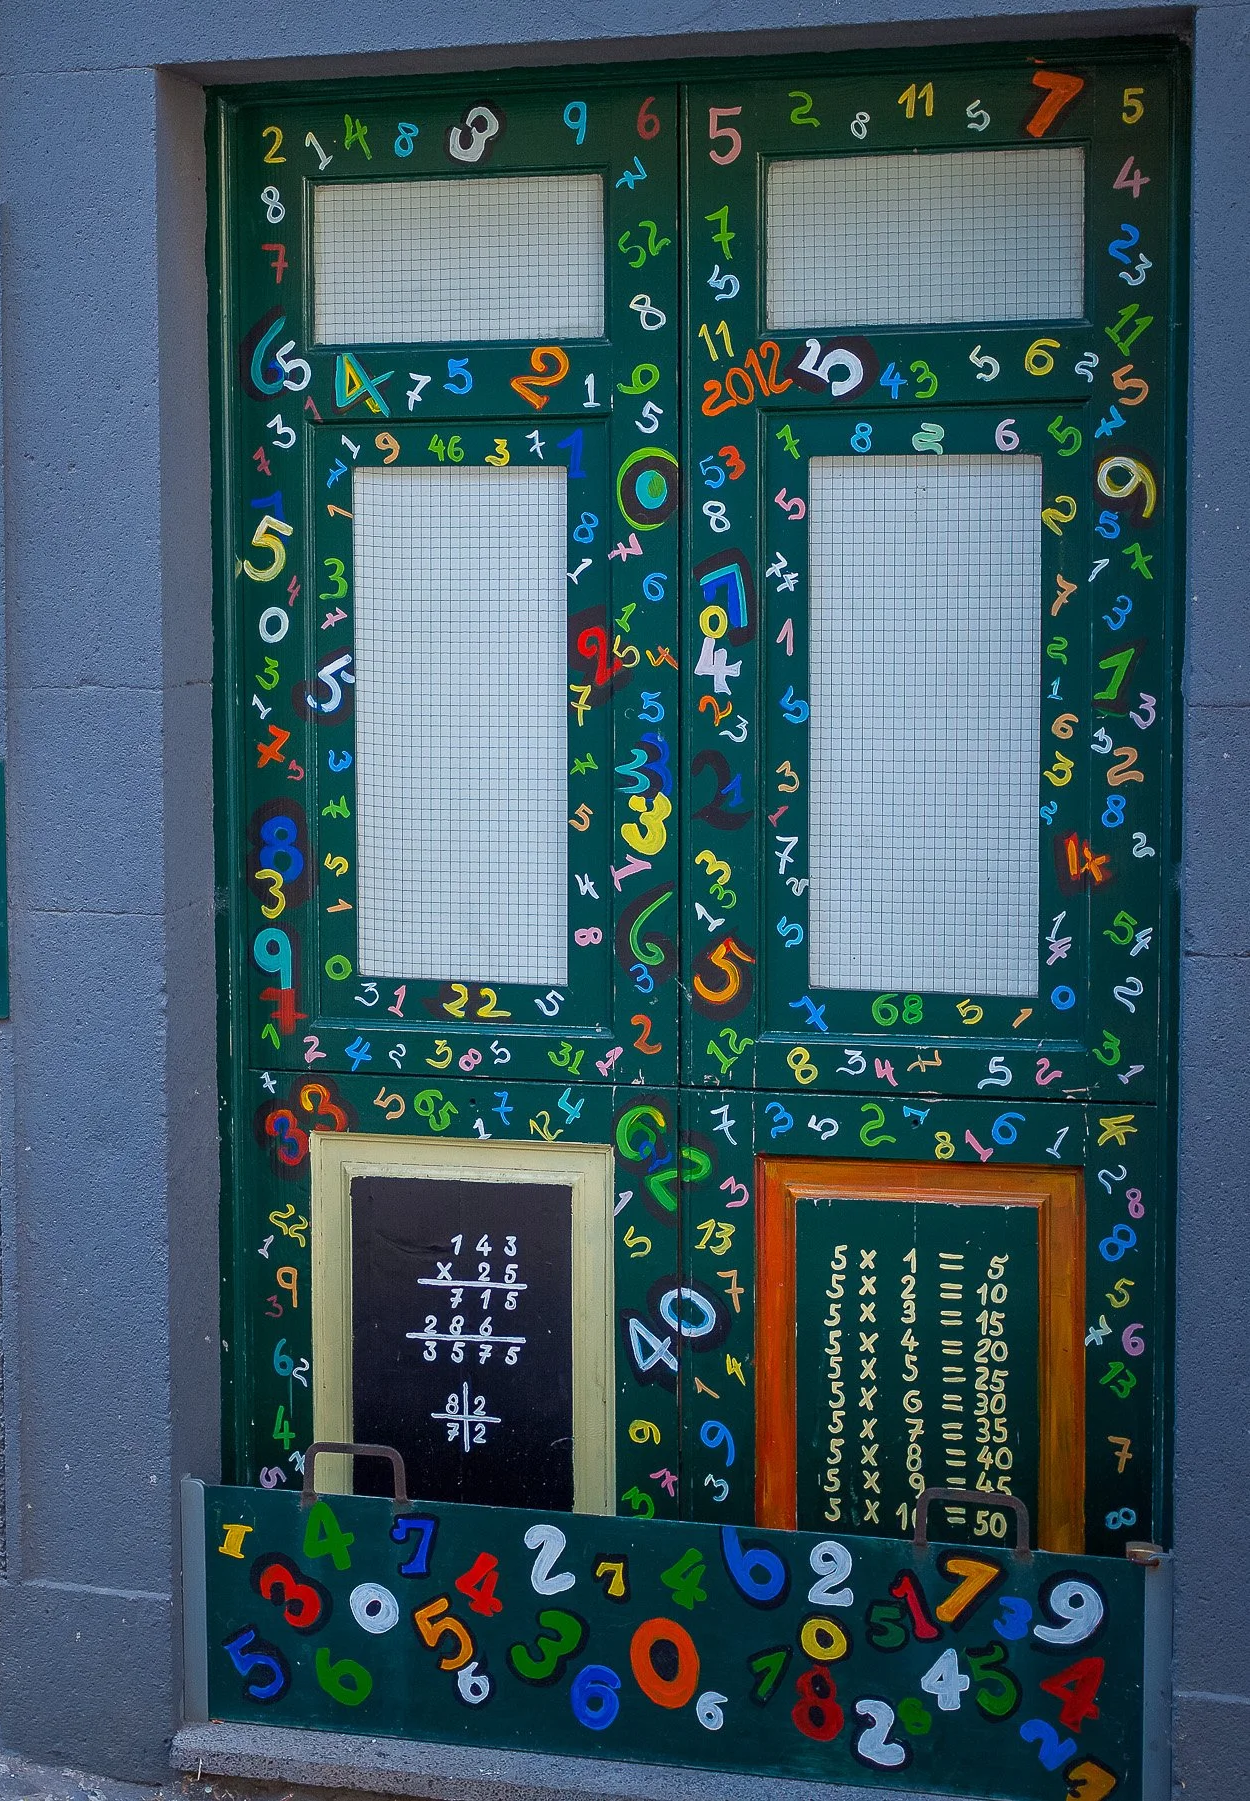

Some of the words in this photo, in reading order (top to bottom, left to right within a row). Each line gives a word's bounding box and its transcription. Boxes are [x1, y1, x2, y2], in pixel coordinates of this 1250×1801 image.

[563, 101, 587, 145] 9
[637, 96, 660, 140] 6
[1026, 71, 1085, 138] 7
[1122, 87, 1144, 124] 5
[262, 126, 286, 164] 2
[708, 106, 742, 165] 5
[1113, 156, 1150, 197] 4
[261, 186, 285, 223] 8
[262, 244, 288, 284] 7
[443, 358, 473, 394] 5
[1024, 338, 1060, 376] 6
[510, 347, 569, 411] 2
[583, 373, 600, 409] 1
[701, 341, 793, 416] 2012
[851, 422, 873, 452] 8
[995, 418, 1020, 451] 6
[776, 836, 799, 874] 7
[254, 928, 292, 990] 9
[786, 1047, 818, 1084] 8
[991, 1112, 1025, 1145] 6
[831, 1244, 848, 1270] 5
[903, 1248, 917, 1273] 1
[988, 1253, 1009, 1279] 5
[276, 1266, 297, 1308] 9
[825, 1274, 846, 1299] 5
[901, 1275, 916, 1300] 2
[976, 1283, 1007, 1306] 10
[824, 1303, 842, 1326] 5
[901, 1300, 916, 1324] 3
[976, 1310, 1005, 1336] 15
[825, 1330, 842, 1355] 5
[901, 1328, 919, 1352] 4
[974, 1338, 1008, 1363] 20
[827, 1357, 843, 1379] 5
[902, 1354, 918, 1382] 5
[974, 1366, 1009, 1393] 25
[445, 1393, 459, 1414] 8
[473, 1396, 486, 1415] 2
[828, 1381, 845, 1409] 5
[903, 1391, 922, 1413] 6
[973, 1393, 1006, 1416] 30
[447, 1423, 459, 1441] 7
[473, 1424, 486, 1443] 2
[828, 1411, 845, 1434] 5
[905, 1418, 924, 1442] 7
[976, 1418, 1007, 1443] 35
[827, 1439, 844, 1464] 5
[906, 1443, 922, 1472] 8
[977, 1446, 1013, 1470] 40
[824, 1468, 841, 1493] 5
[909, 1472, 925, 1499] 9
[976, 1472, 1012, 1496] 45
[303, 1502, 354, 1571] 4
[825, 1498, 842, 1522] 5
[973, 1510, 1007, 1538] 50
[392, 1518, 435, 1574] 7
[524, 1524, 575, 1595] 2
[722, 1525, 785, 1601] 6
[596, 1562, 625, 1597] 7
[808, 1541, 853, 1606] 2
[936, 1559, 999, 1622] 7
[260, 1564, 321, 1627] 3
[1033, 1581, 1104, 1644] 9
[414, 1597, 474, 1670] 5
[511, 1610, 582, 1679] 3
[870, 1606, 905, 1648] 5
[223, 1629, 284, 1698] 5
[315, 1648, 372, 1705] 6
[457, 1662, 489, 1704] 6
[921, 1649, 970, 1710] 4
[571, 1665, 621, 1731] 6
[697, 1691, 728, 1730] 6
[792, 1666, 844, 1741] 8
